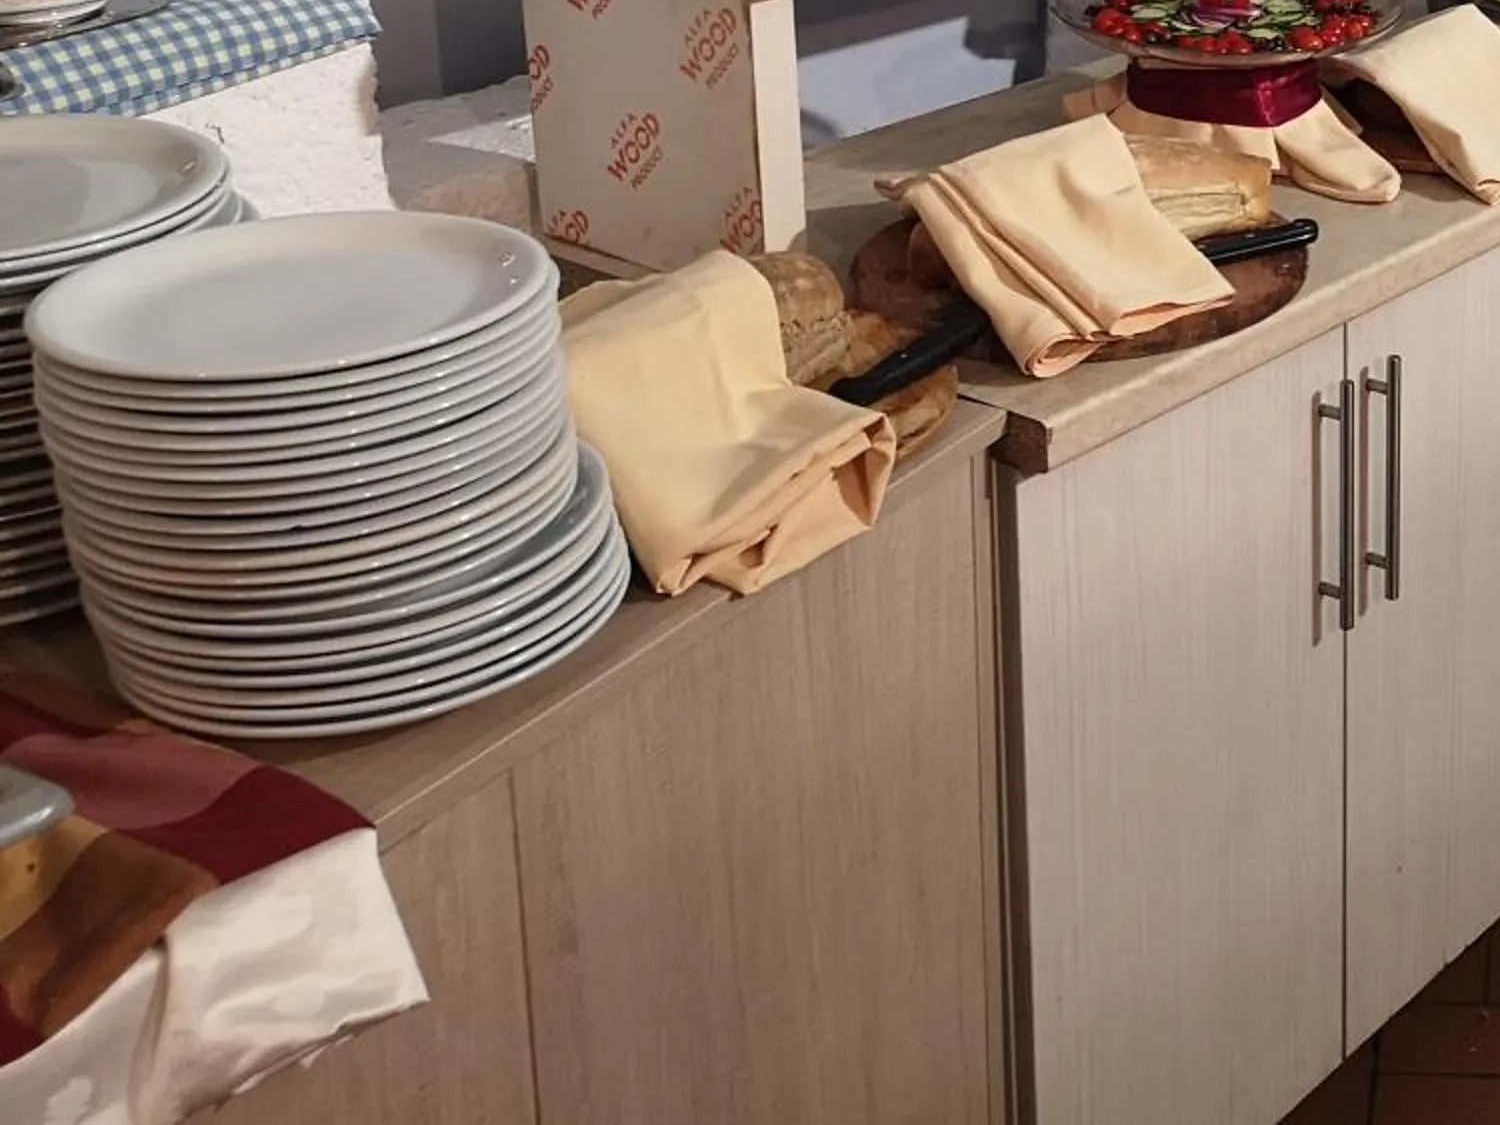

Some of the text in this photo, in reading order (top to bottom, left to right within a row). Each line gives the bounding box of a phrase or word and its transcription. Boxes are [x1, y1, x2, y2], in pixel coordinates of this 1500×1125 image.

[680, 8, 736, 80] WOOD
[684, 9, 712, 47] ALFA
[528, 44, 549, 80] OD
[607, 113, 659, 180] WOOD
[611, 114, 637, 148] ALFA
[724, 186, 753, 223] ALFA
[719, 200, 762, 254] WOO
